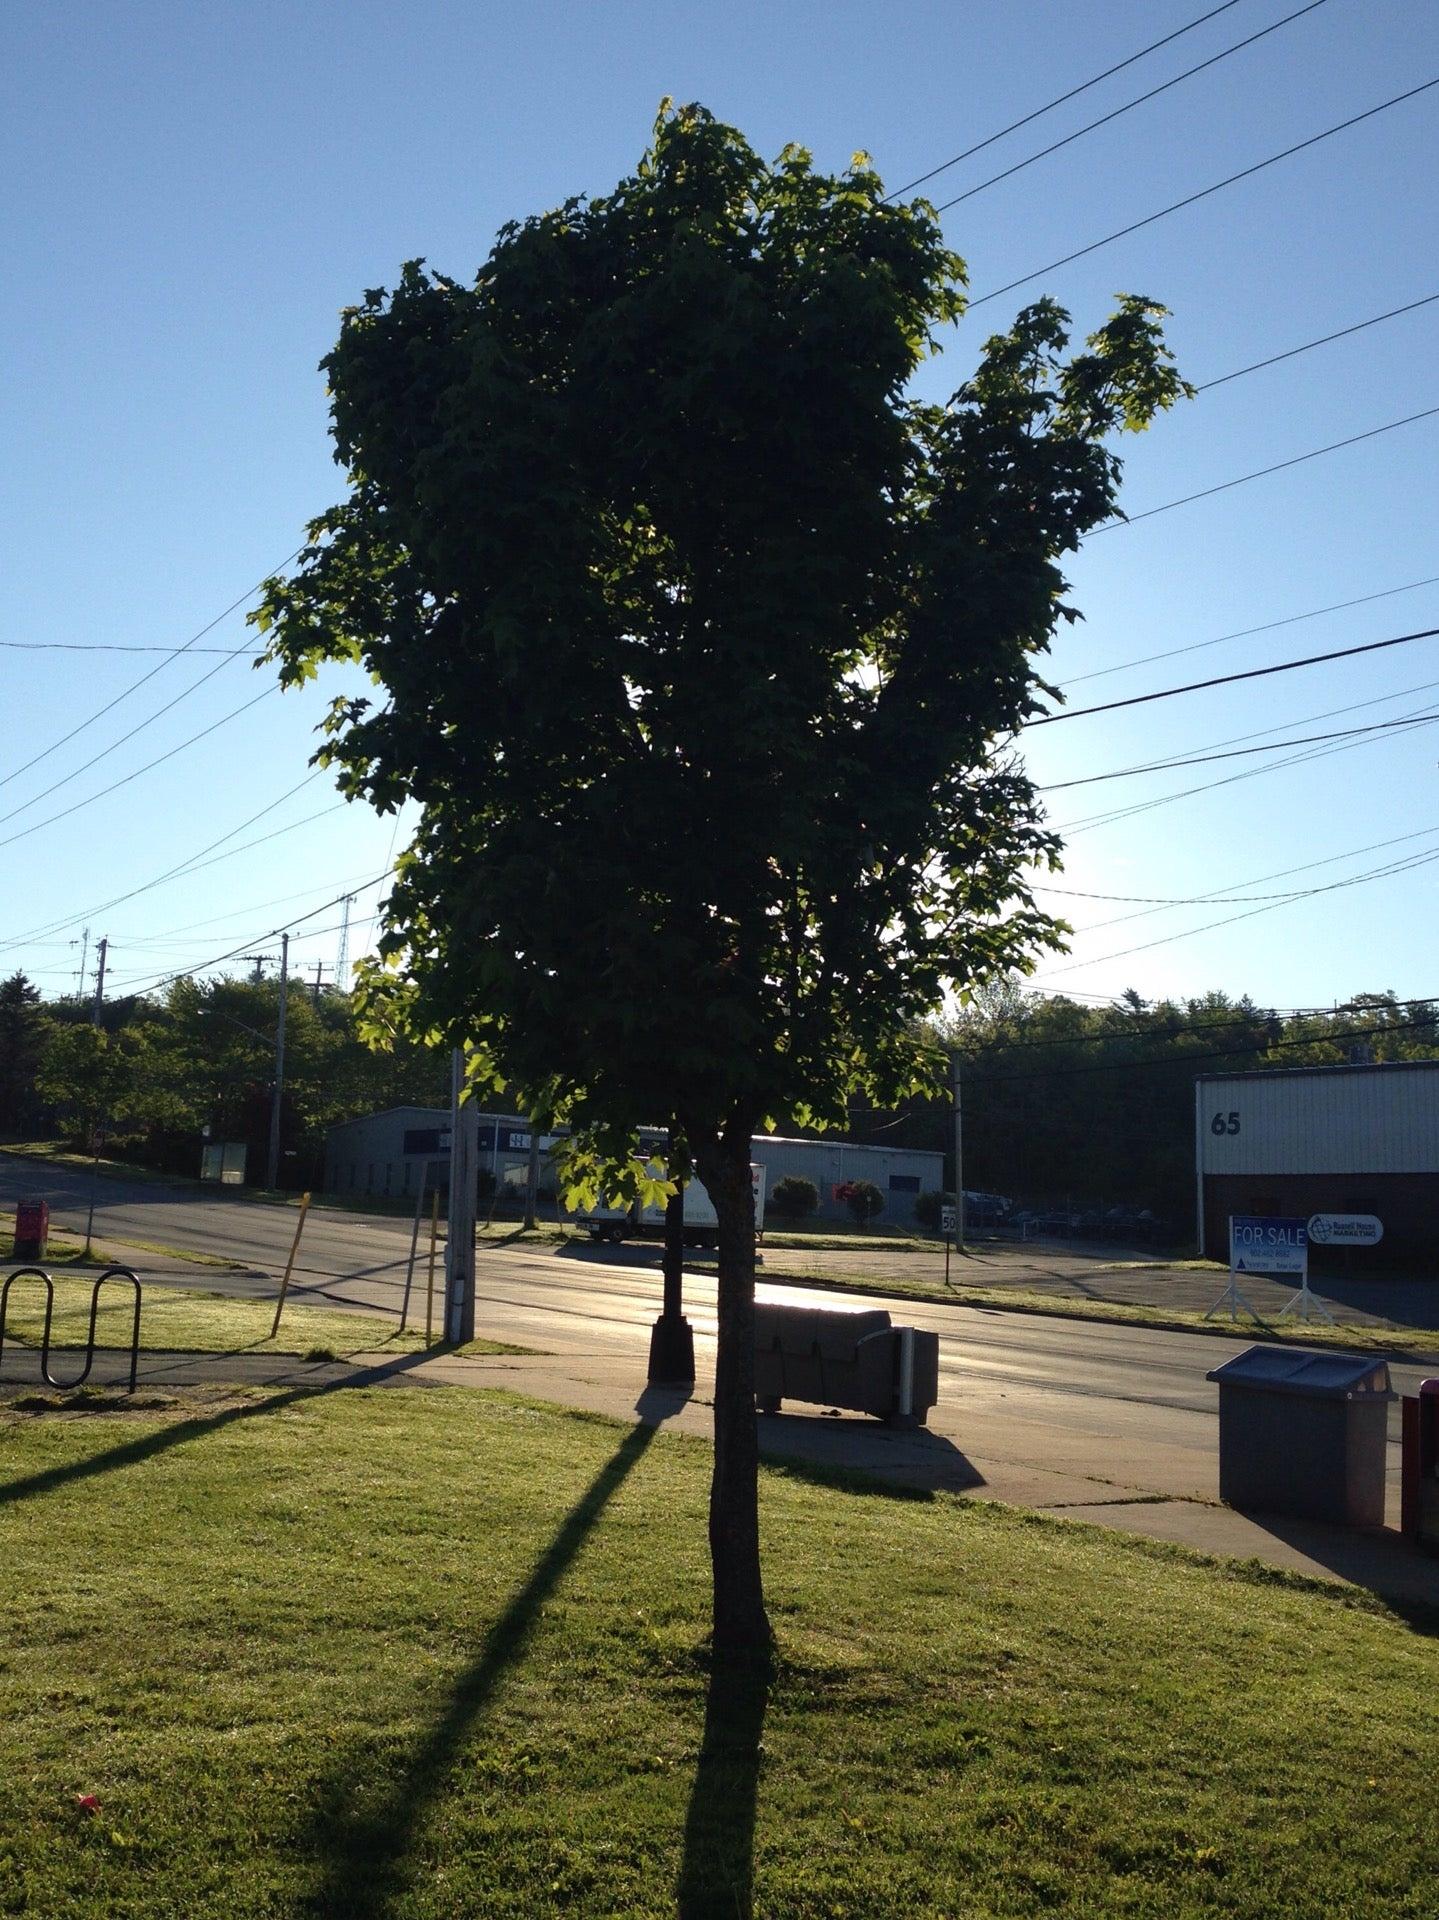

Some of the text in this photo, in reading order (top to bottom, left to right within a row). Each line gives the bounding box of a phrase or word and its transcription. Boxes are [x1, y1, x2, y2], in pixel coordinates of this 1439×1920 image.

[1211, 1112, 1241, 1136] 65
[943, 1216, 956, 1229] 50
[1234, 1226, 1306, 1247] FOR SALE
